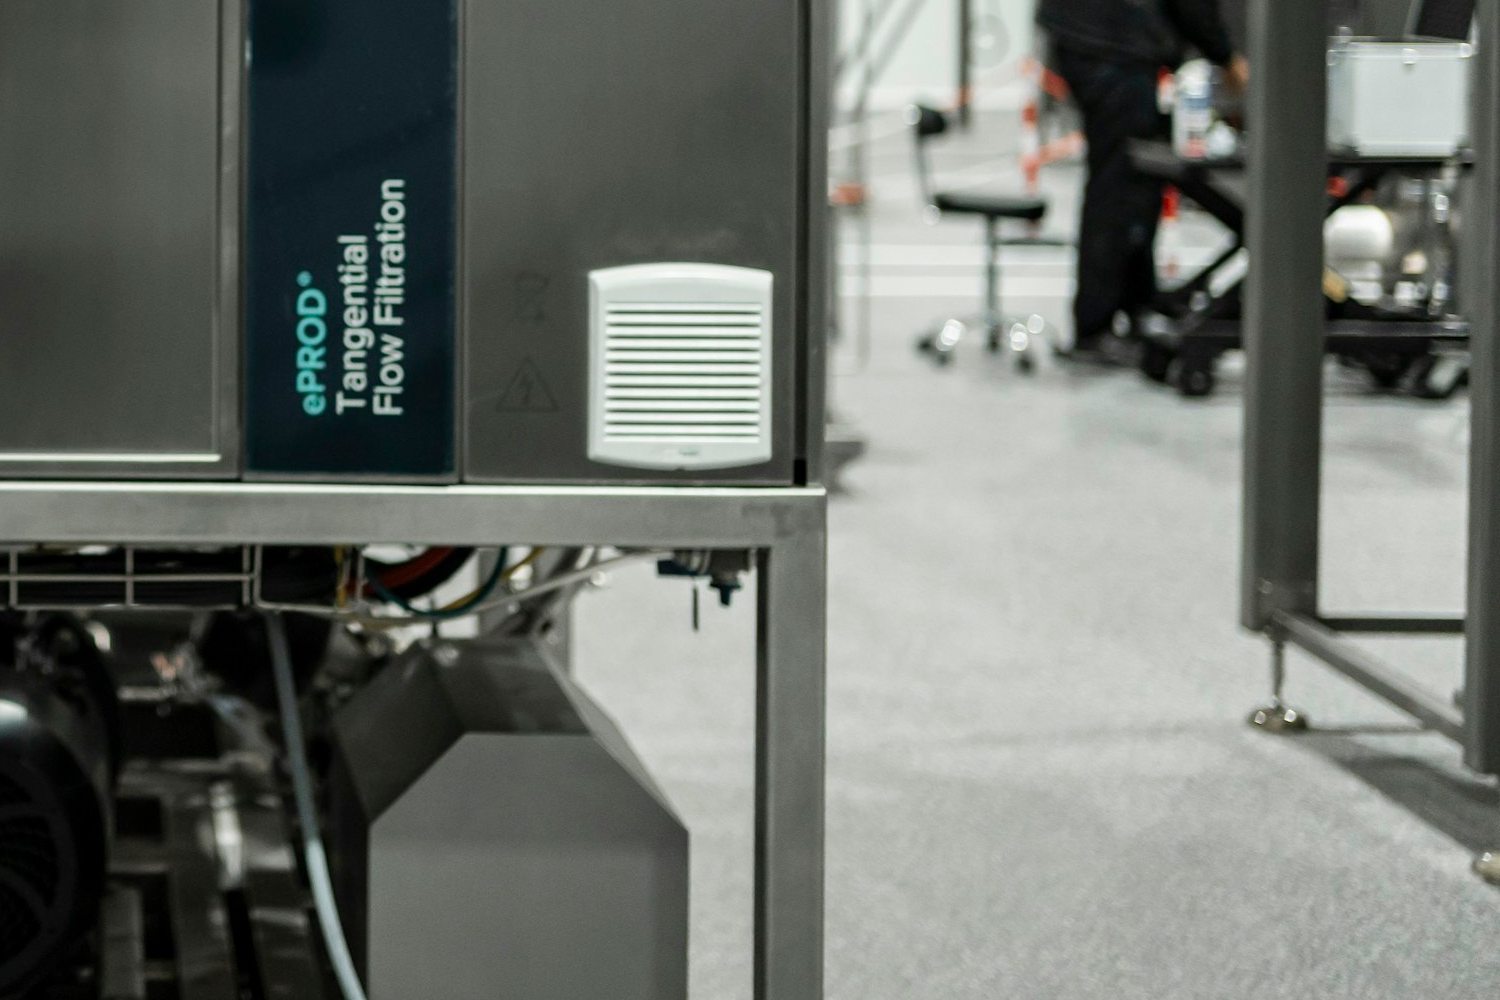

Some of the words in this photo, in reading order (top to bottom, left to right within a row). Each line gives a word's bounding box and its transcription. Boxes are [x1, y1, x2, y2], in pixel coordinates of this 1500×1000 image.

[336, 235, 374, 416] Tangential
[373, 178, 406, 326] Filtration
[372, 334, 405, 416] Flow
